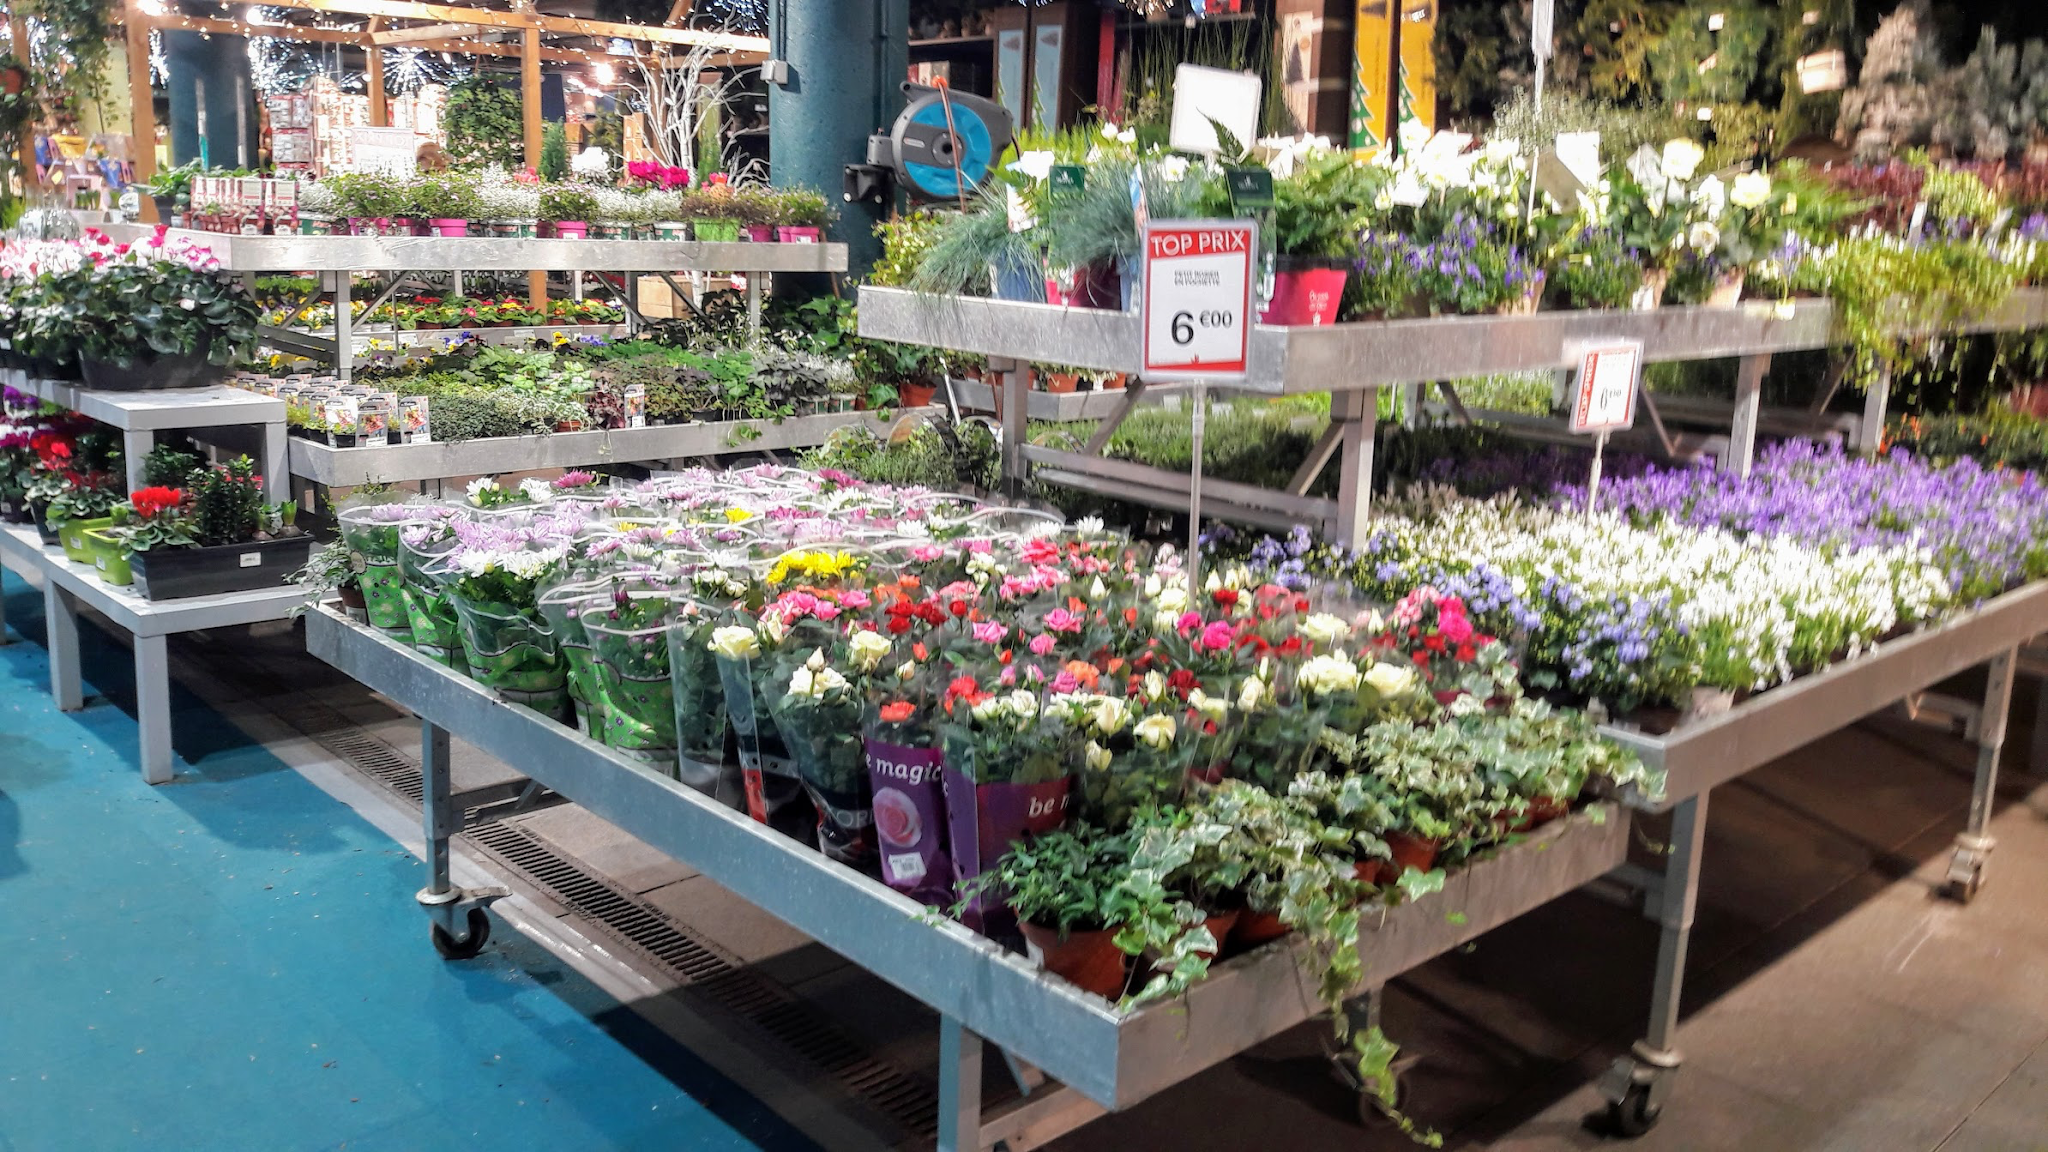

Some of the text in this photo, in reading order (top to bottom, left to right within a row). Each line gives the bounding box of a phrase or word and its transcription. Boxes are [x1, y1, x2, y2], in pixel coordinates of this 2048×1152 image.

[1151, 229, 1246, 257] TOP PRIX
[876, 757, 942, 785] magic
